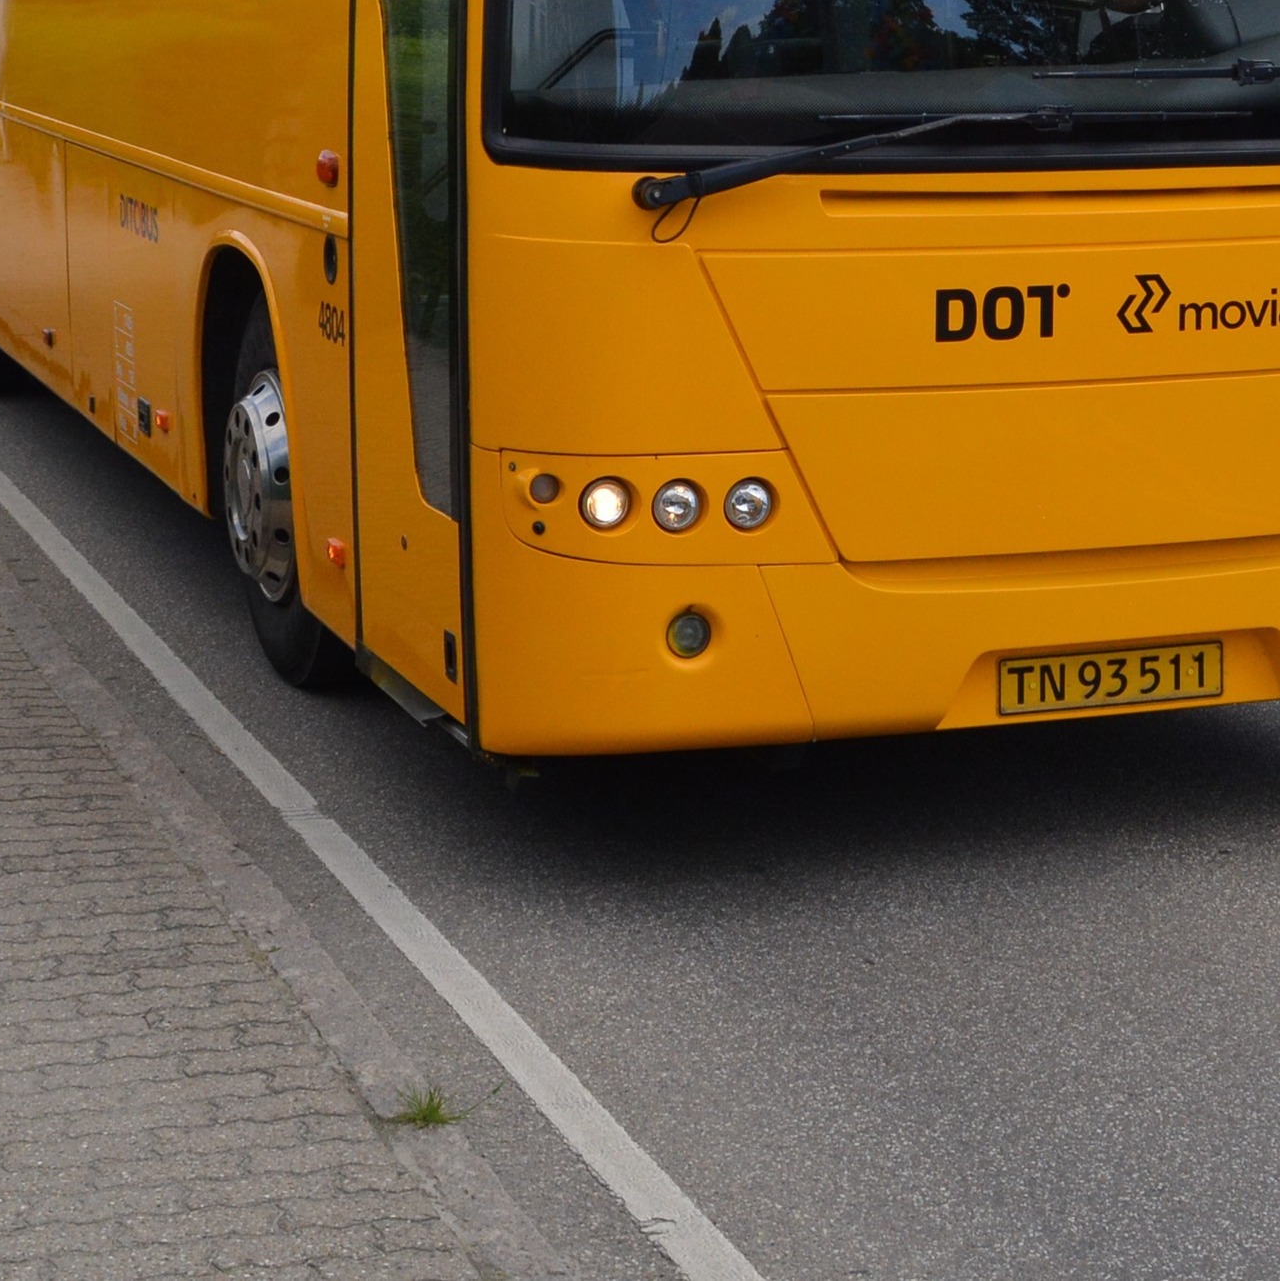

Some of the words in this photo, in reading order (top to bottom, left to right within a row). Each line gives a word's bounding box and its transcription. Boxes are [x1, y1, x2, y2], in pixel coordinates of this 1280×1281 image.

[119, 194, 159, 244] DITOBUS
[318, 300, 346, 347] 4804
[934, 283, 1070, 343] DOT
